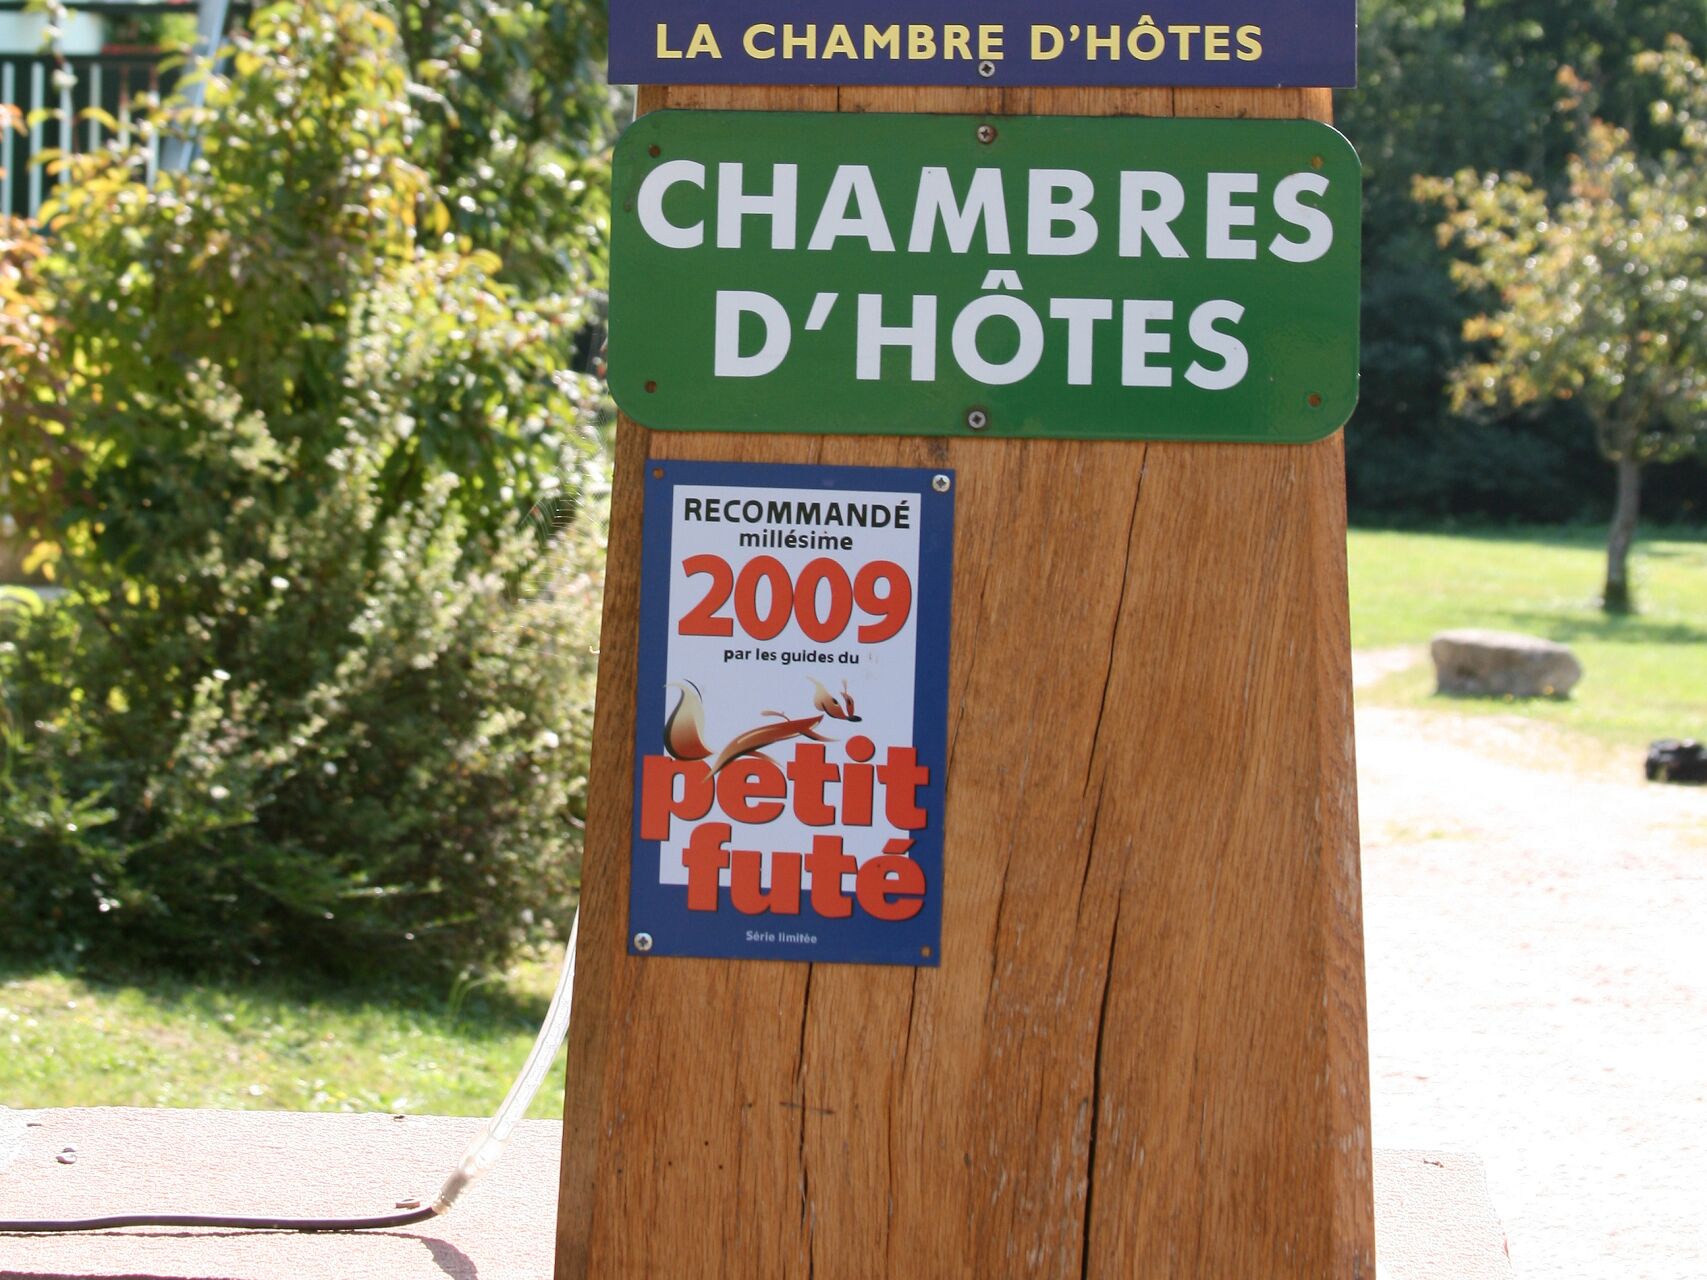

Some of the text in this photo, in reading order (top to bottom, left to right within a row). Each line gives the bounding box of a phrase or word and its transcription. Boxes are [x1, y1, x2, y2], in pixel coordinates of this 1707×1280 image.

[656, 15, 1263, 62] LA CHAMBRE D'HÔTES
[637, 159, 1333, 263] CHAMBRES
[713, 269, 1249, 390] D'HÔTES
[684, 498, 911, 529] RECOMMANDÉ
[739, 529, 853, 551] millésime
[678, 553, 912, 644] 2009
[724, 648, 859, 665] par les guides du
[640, 735, 930, 841] petit
[682, 822, 926, 921] futé
[746, 930, 818, 944] Série limitée
